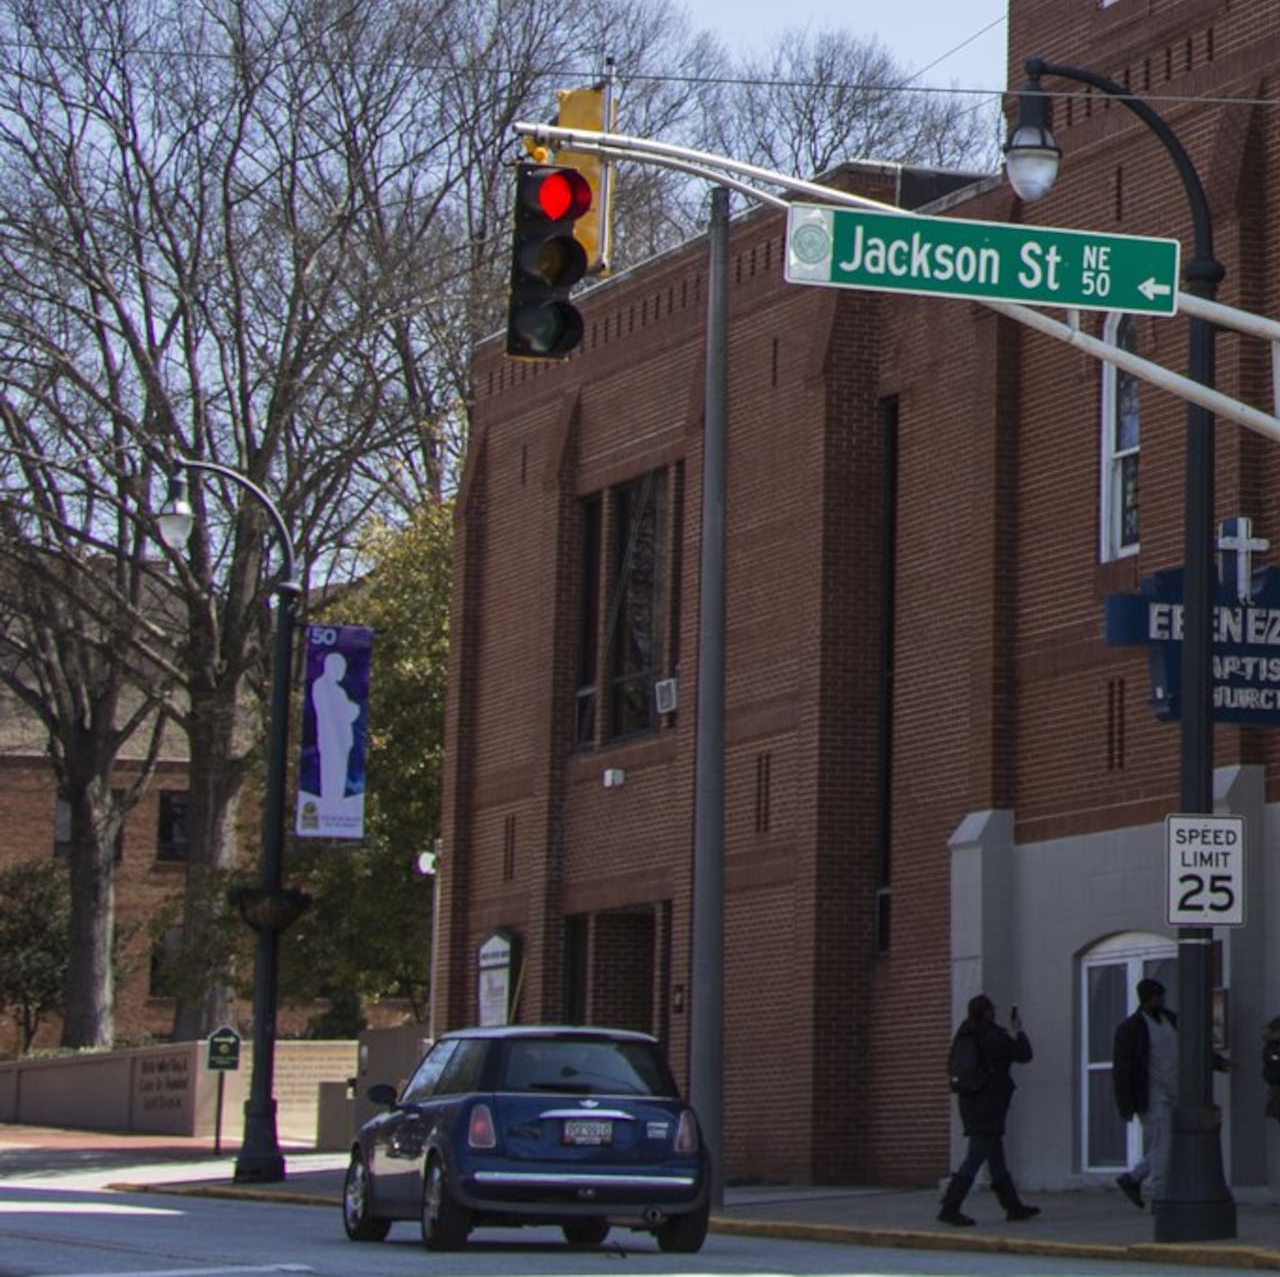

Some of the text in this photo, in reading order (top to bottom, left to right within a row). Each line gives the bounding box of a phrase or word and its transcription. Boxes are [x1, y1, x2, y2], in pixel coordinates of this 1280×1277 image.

[839, 225, 1060, 290] Jackson St
[1082, 245, 1111, 271] NE
[1081, 271, 1111, 297] 50
[1175, 828, 1236, 846] SPEED
[1180, 851, 1231, 868] LIMIT
[1177, 874, 1234, 912] 25
